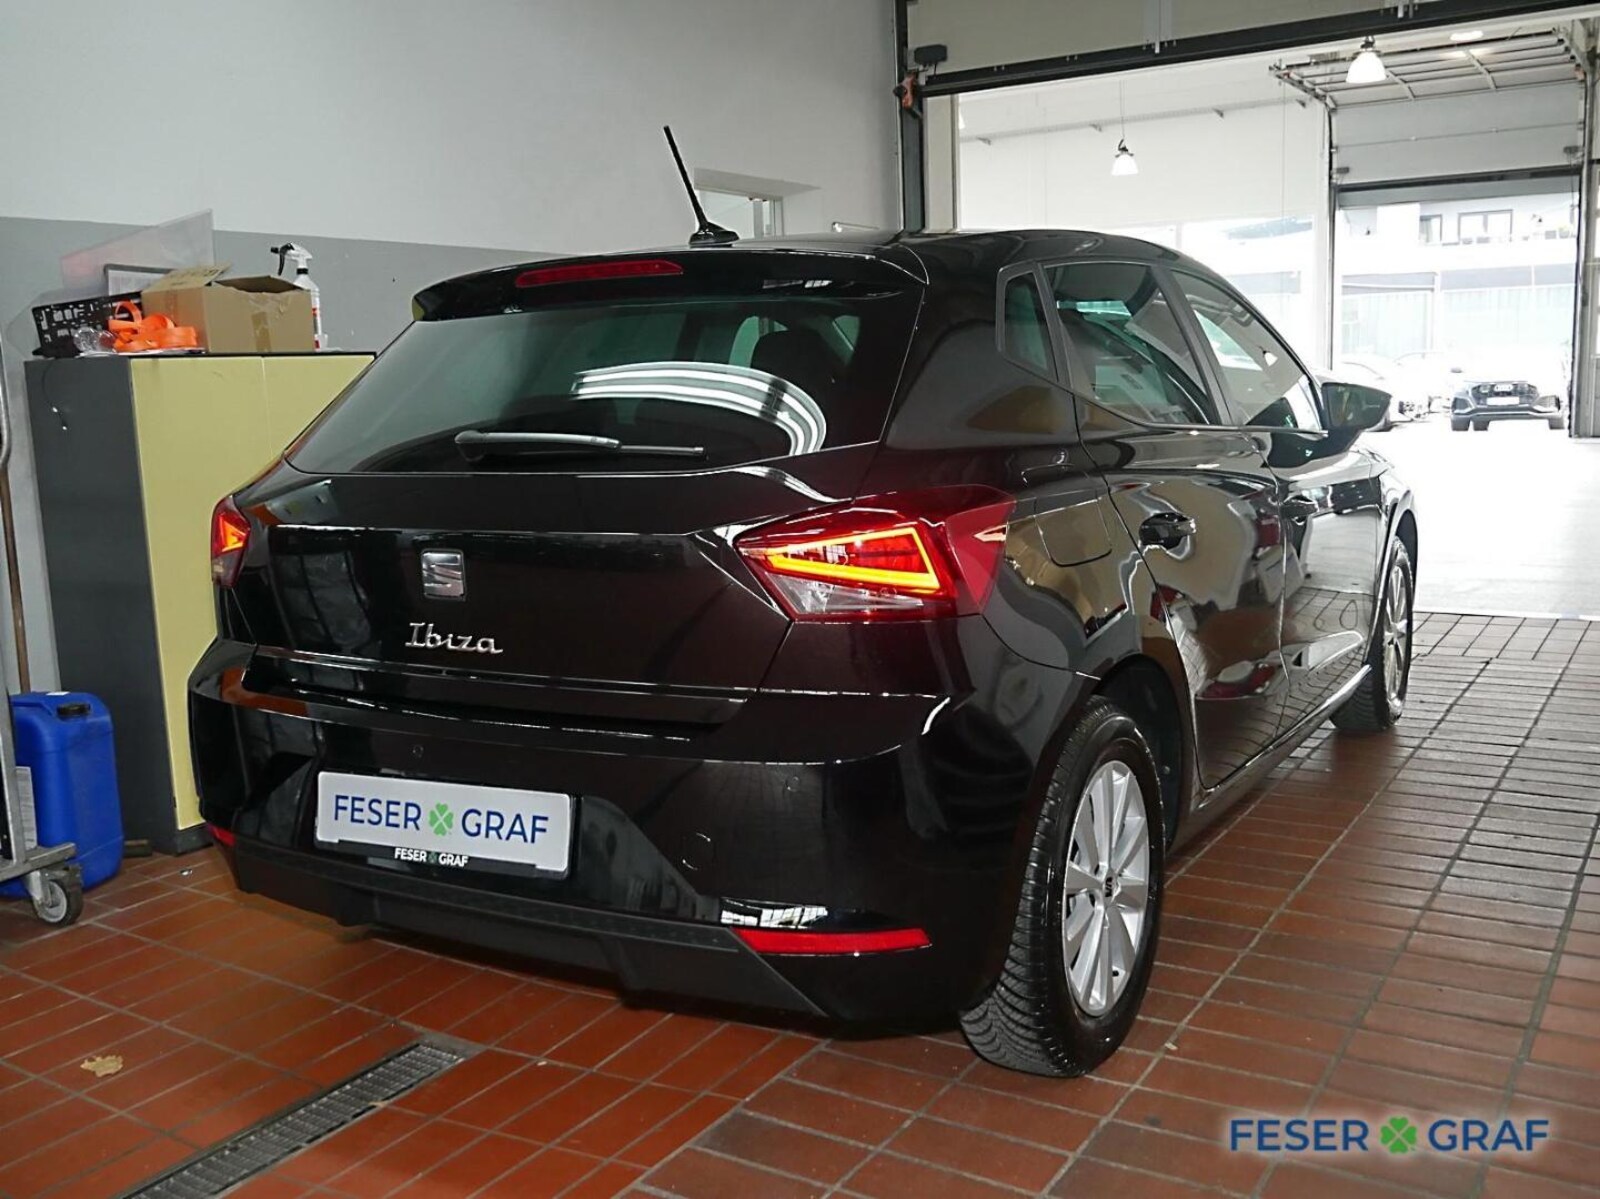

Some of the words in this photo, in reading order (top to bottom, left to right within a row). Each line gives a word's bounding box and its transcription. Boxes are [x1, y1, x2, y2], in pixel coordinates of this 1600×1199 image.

[405, 622, 504, 654] Ibiza
[333, 794, 422, 831] FESER
[461, 808, 549, 844] GRAF
[394, 847, 427, 863] FESER
[438, 853, 469, 867] GRAF
